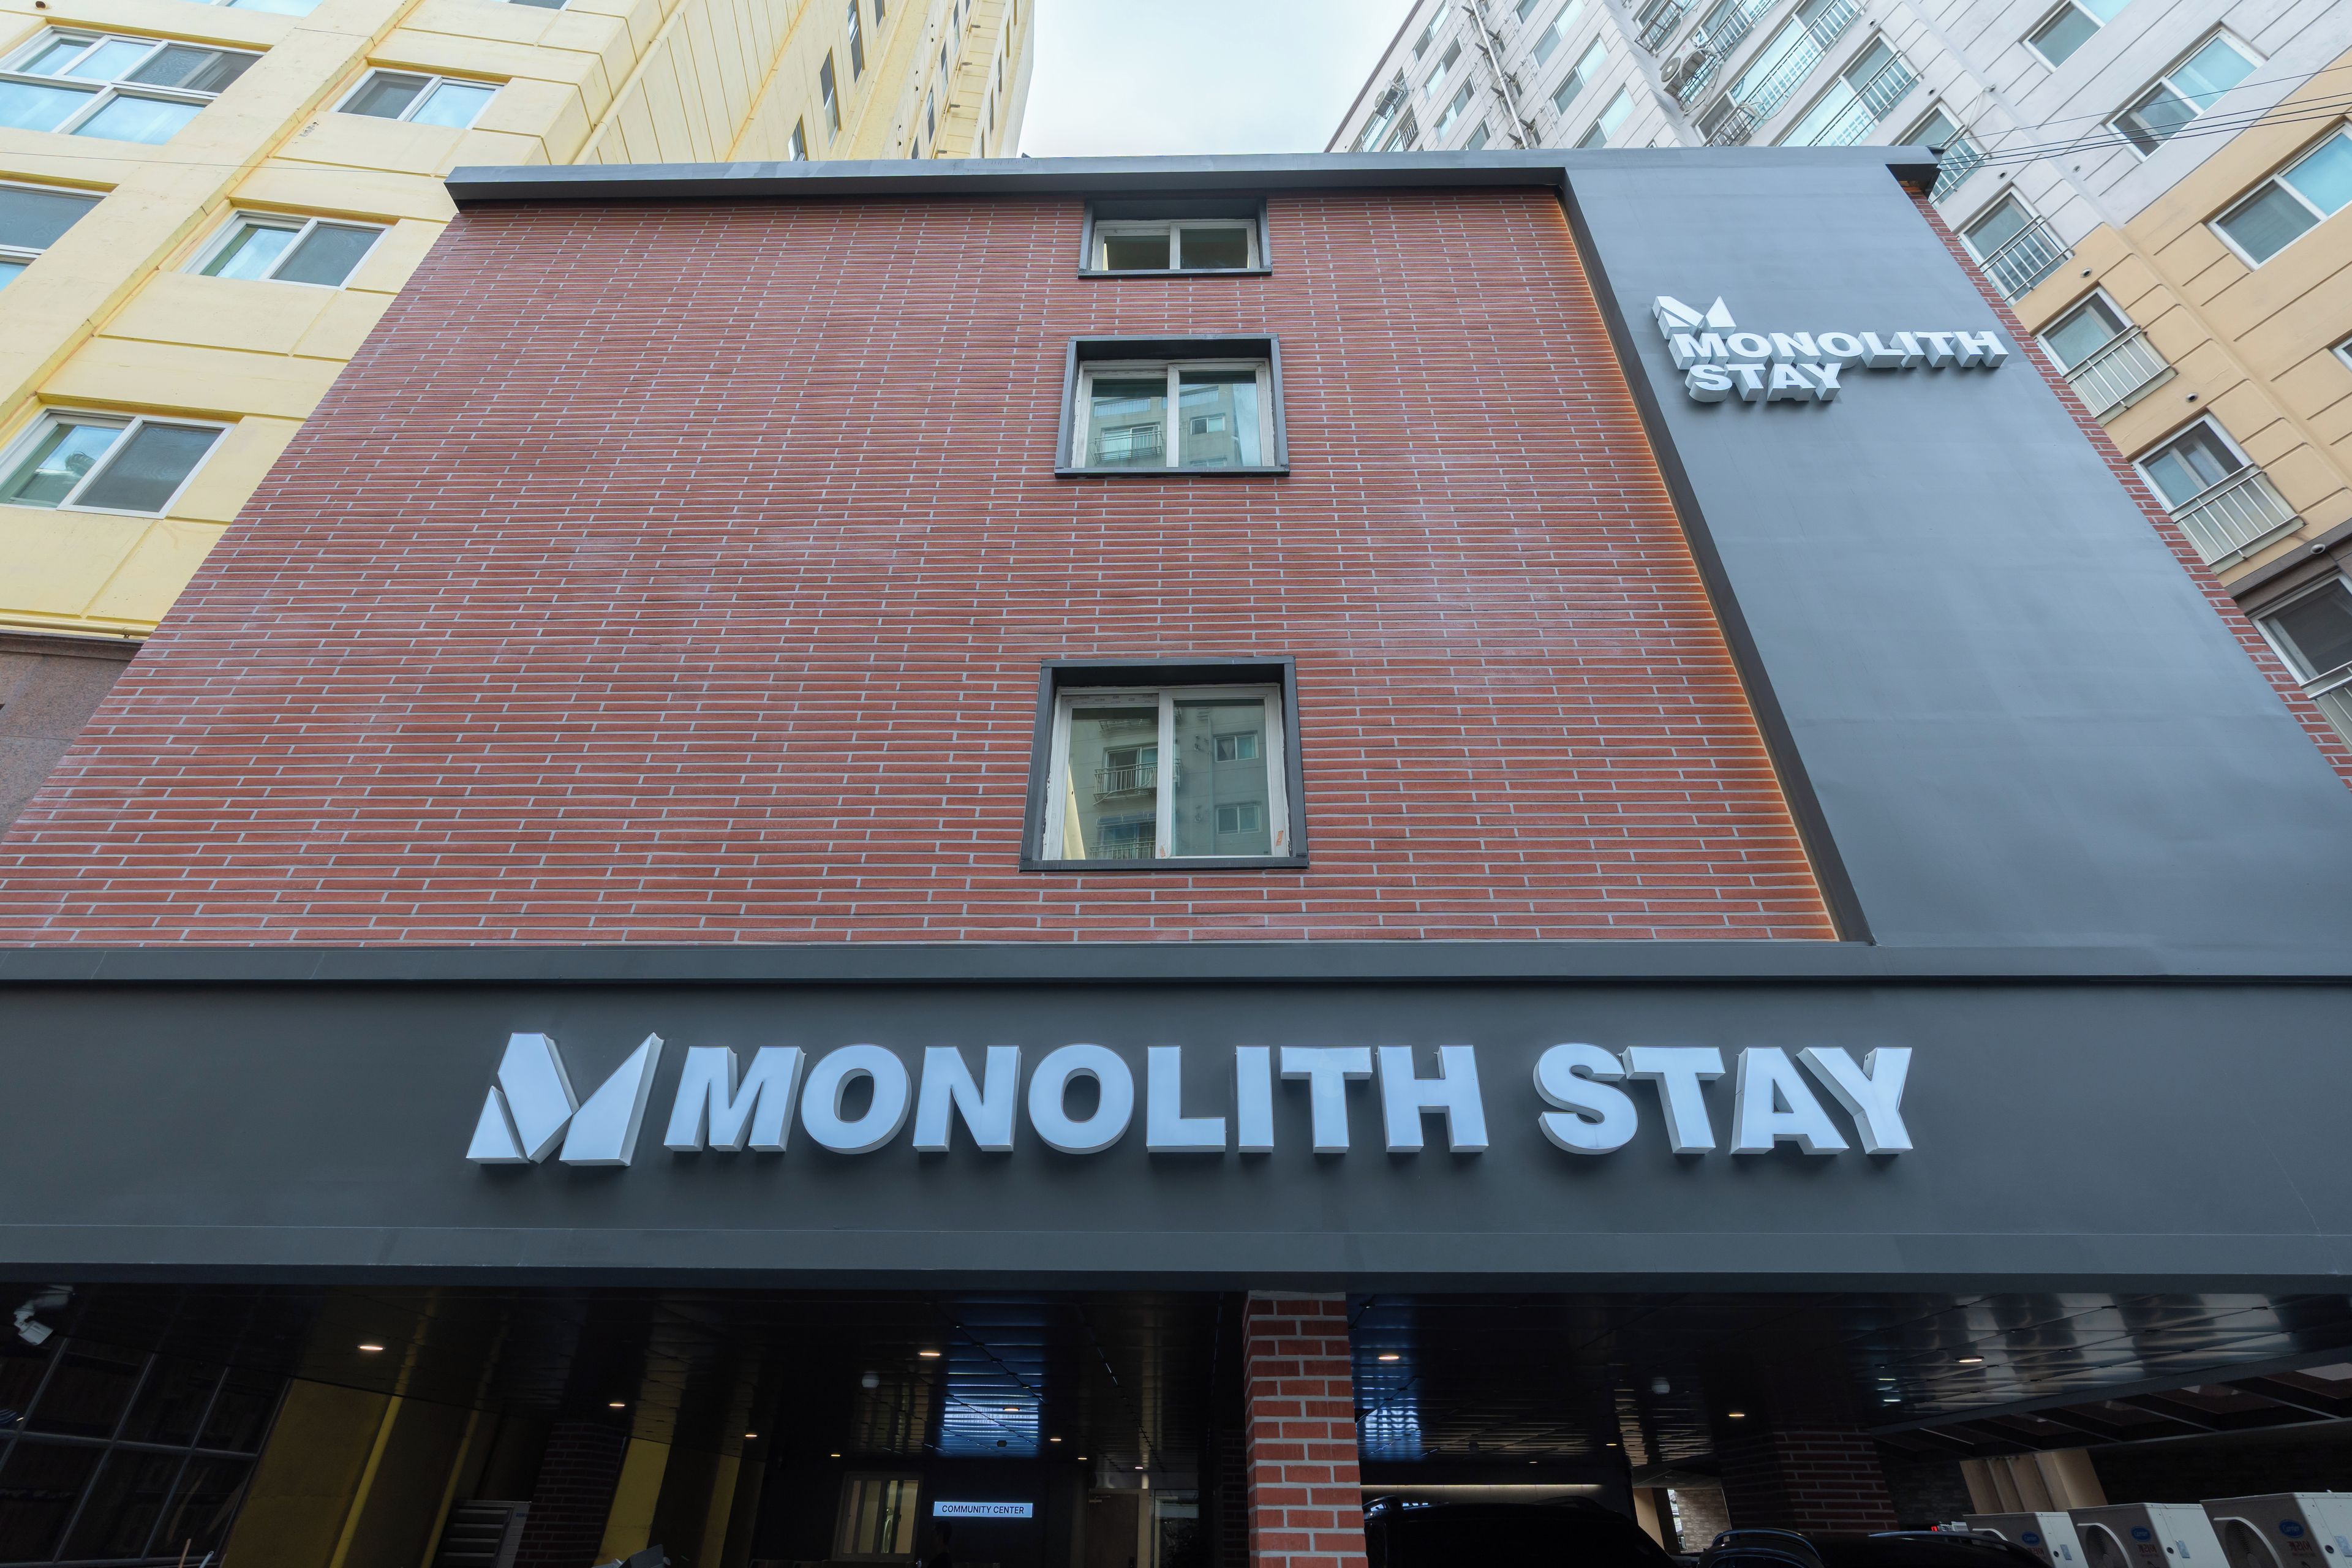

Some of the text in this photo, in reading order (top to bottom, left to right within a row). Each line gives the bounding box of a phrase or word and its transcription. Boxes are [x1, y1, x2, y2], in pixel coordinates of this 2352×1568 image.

[1668, 331, 2009, 369] MONOLITH
[1685, 363, 1842, 402] STAY
[663, 1043, 1489, 1155] MONOLITH
[1533, 1042, 1913, 1155] STAY
[942, 1504, 1025, 1514] COMMUNITY CENTER
